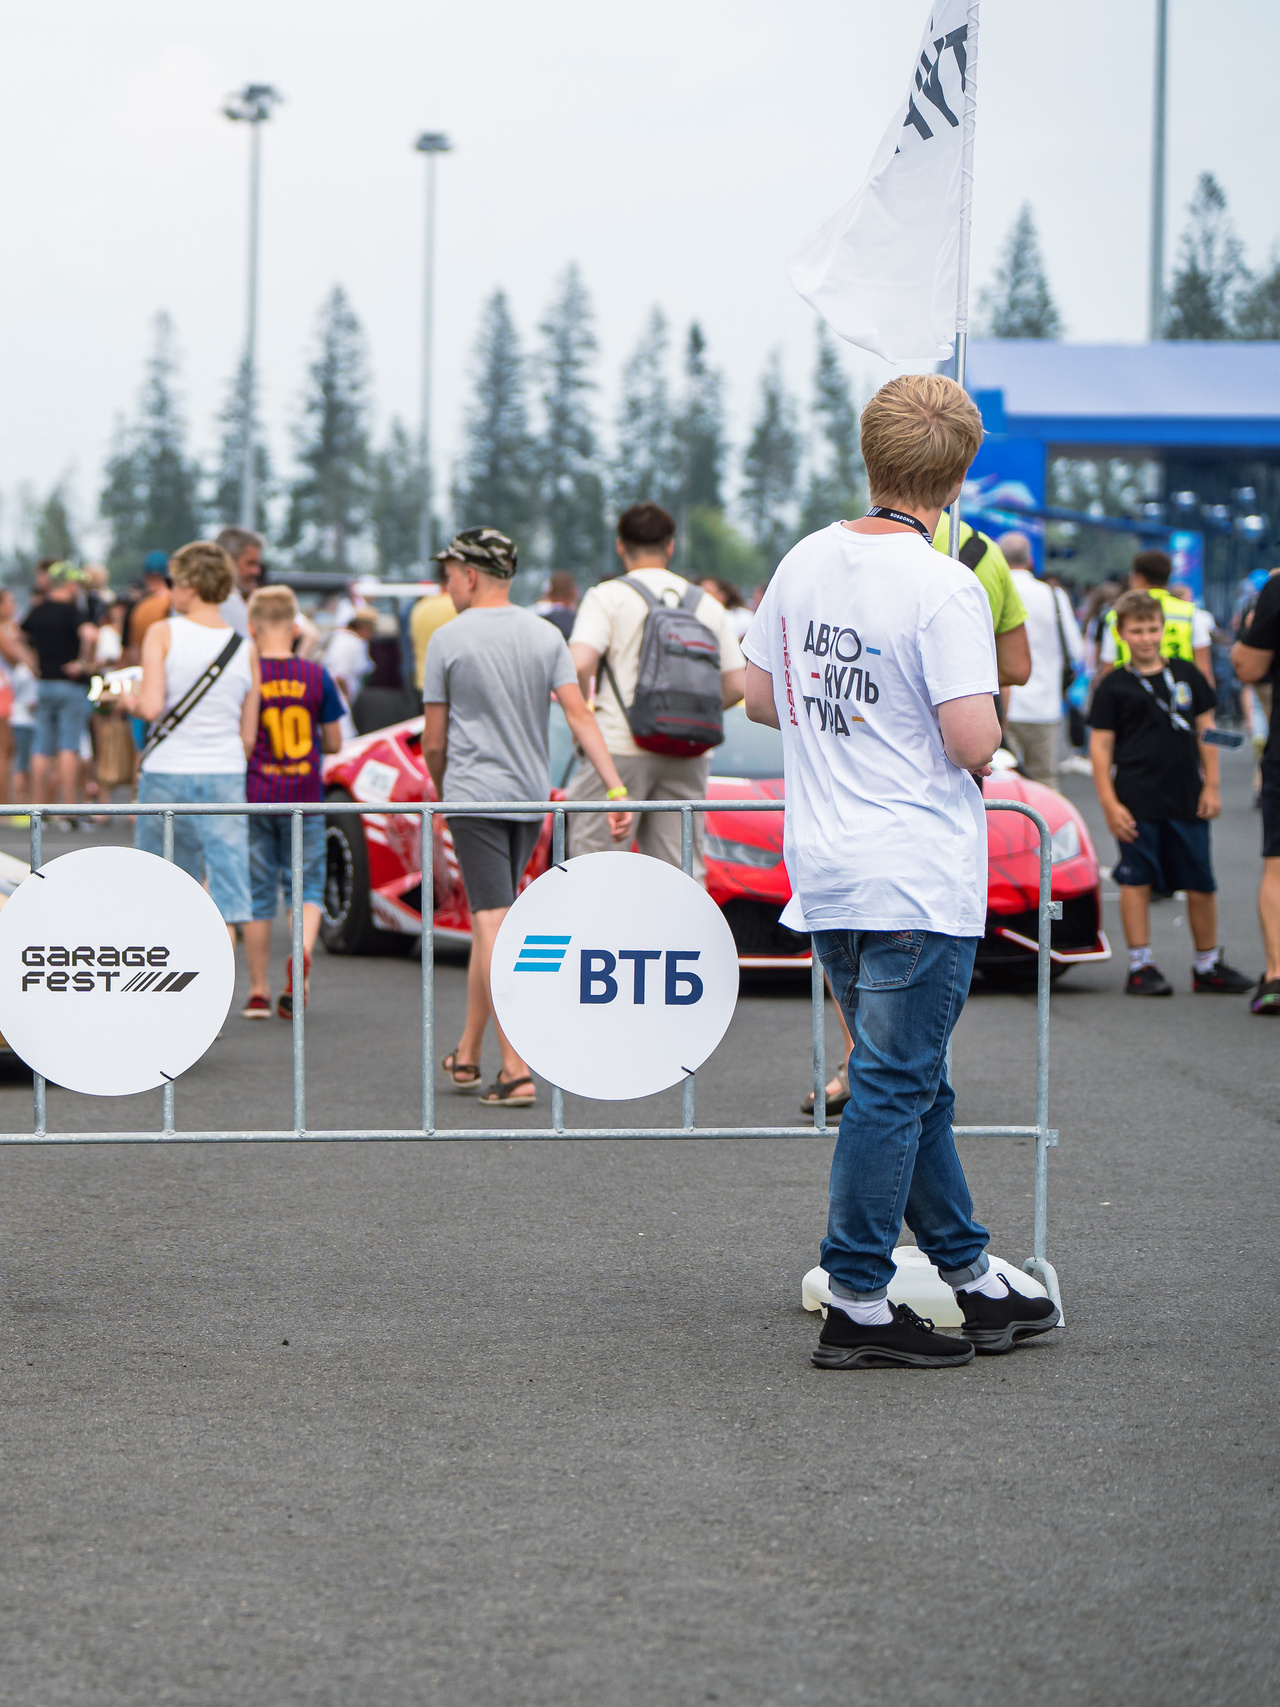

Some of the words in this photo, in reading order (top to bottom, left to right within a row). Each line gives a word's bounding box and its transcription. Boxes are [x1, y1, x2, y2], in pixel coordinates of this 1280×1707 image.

[803, 620, 862, 663] АВТО
[262, 705, 312, 760] 10
[802, 695, 851, 737] ТУРА
[579, 949, 704, 1005] ВТБ
